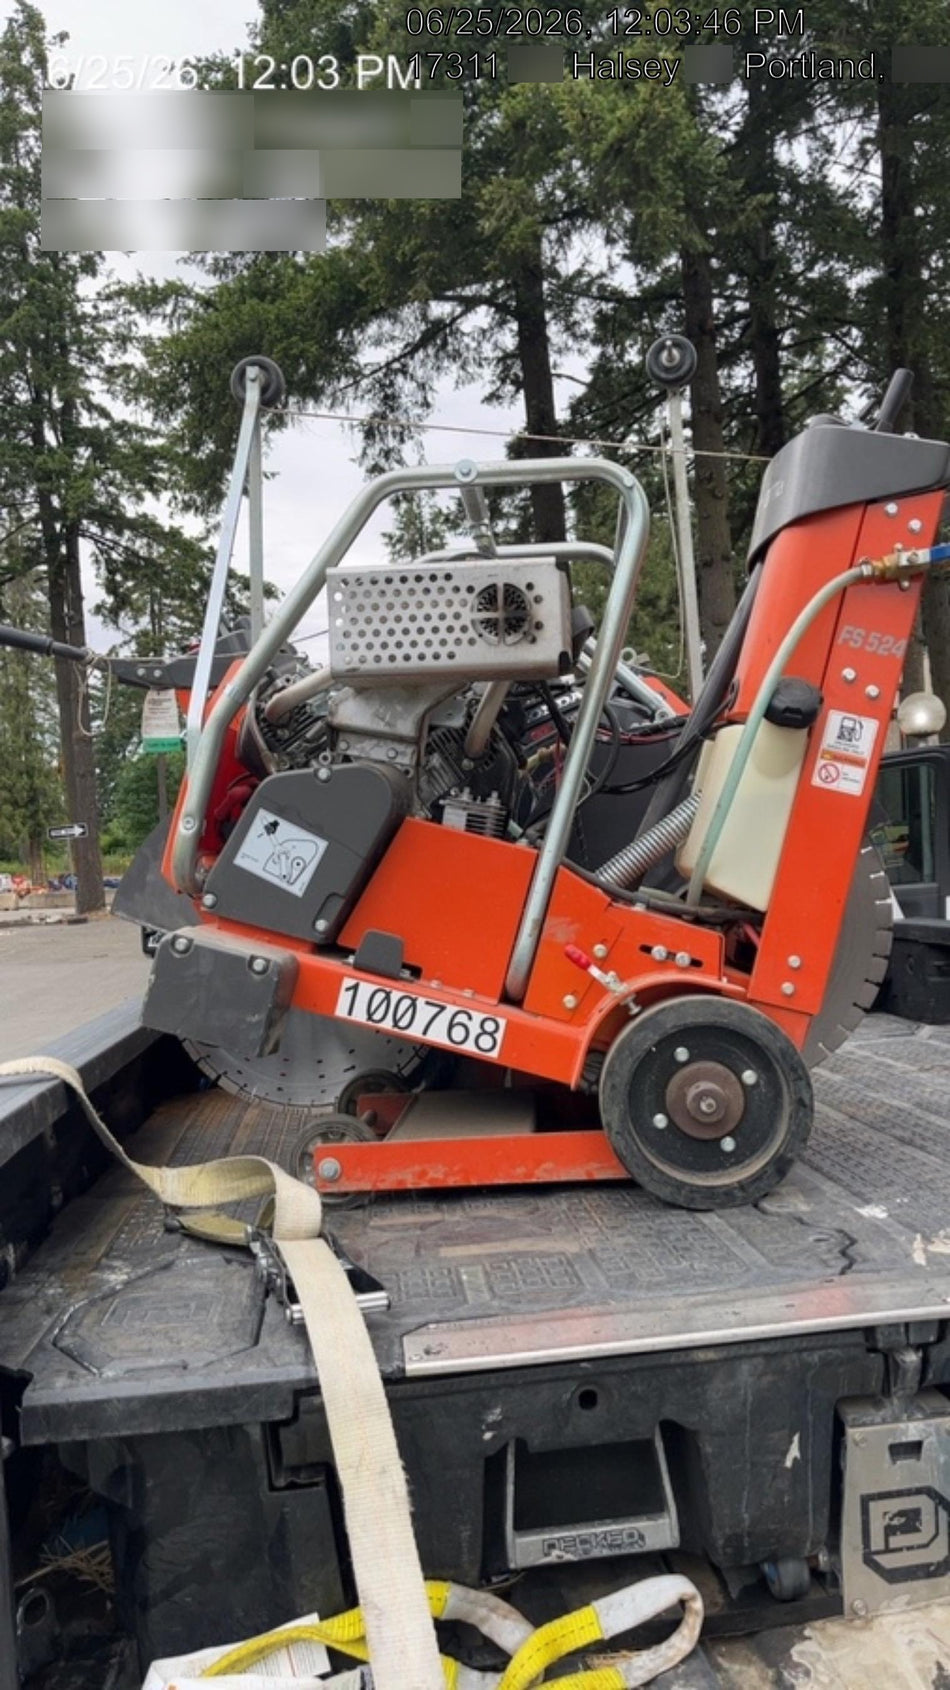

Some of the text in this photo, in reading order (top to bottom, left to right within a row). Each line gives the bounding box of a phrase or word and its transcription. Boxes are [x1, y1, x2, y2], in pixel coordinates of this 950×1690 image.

[837, 625, 908, 659] FS 524
[344, 981, 500, 1053] 100768
